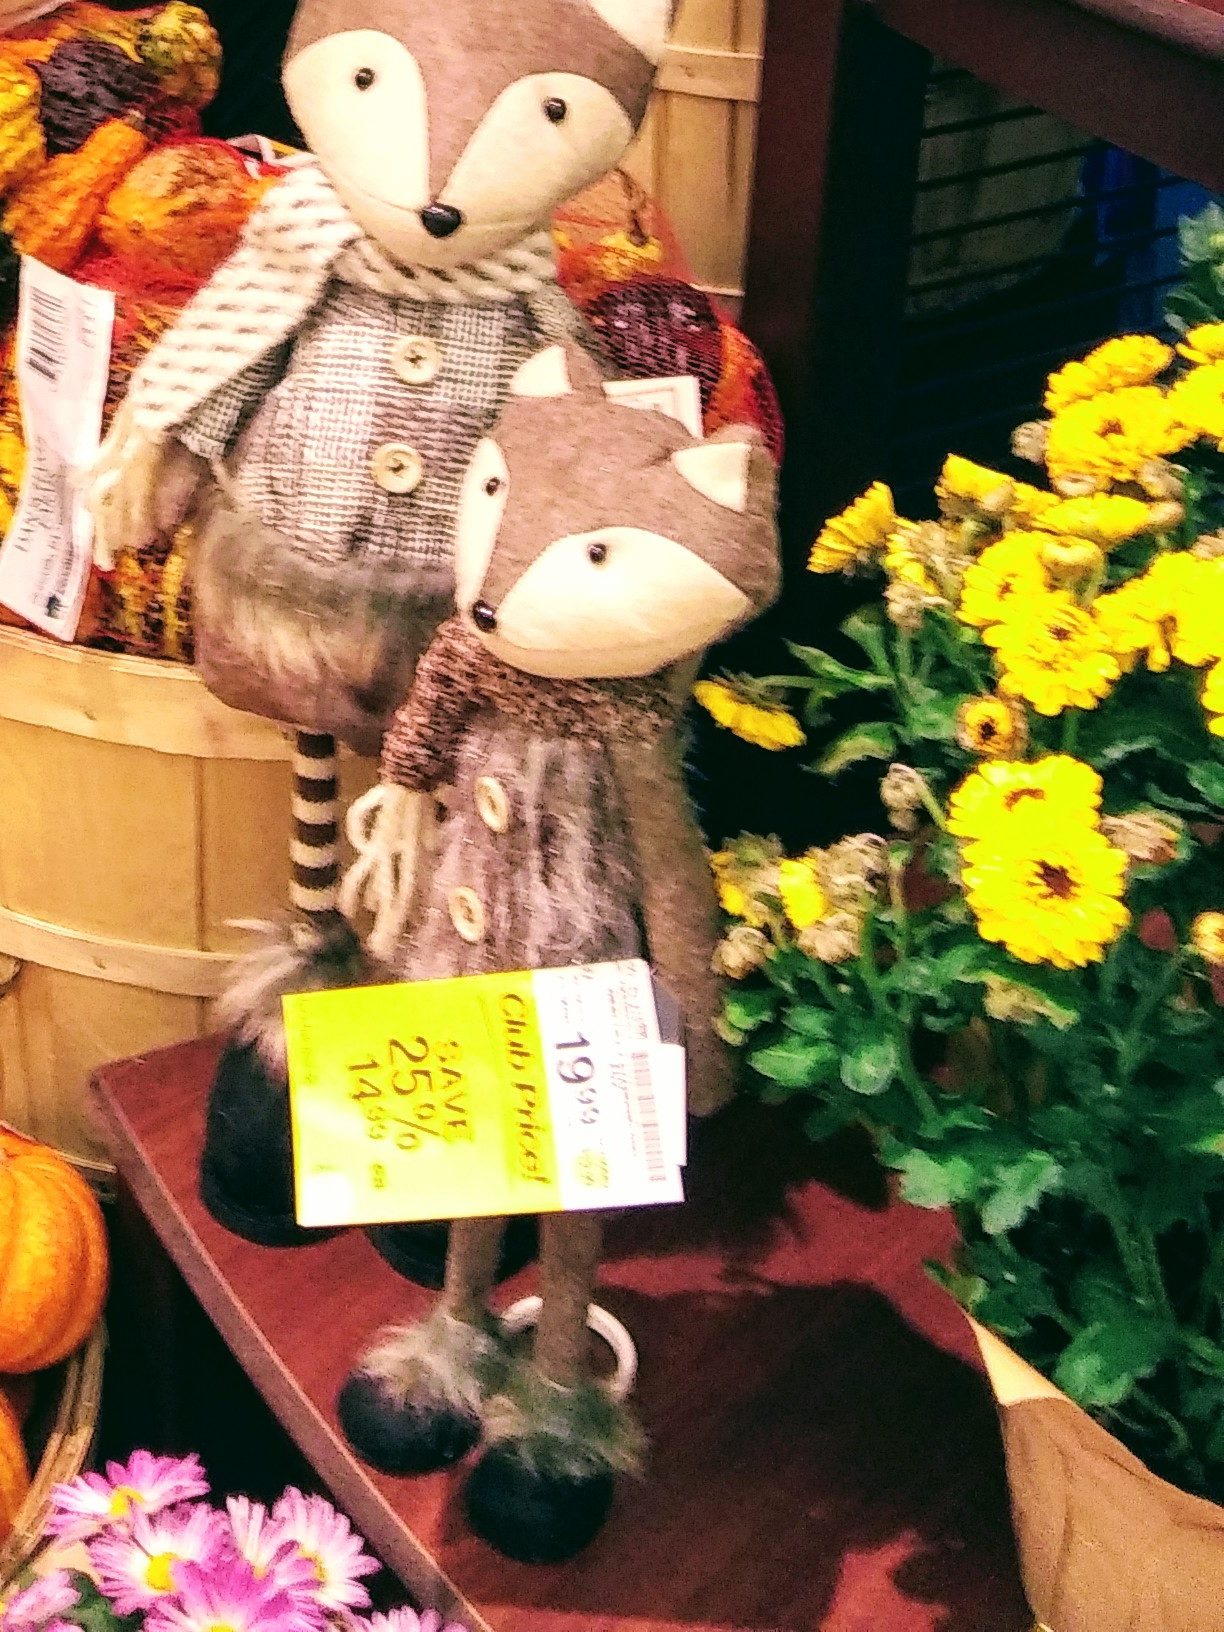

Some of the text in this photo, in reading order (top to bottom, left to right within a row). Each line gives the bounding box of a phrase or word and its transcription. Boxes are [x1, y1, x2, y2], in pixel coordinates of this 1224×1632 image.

[387, 1035, 445, 1150] 25%
[434, 1039, 473, 1142] SAVE
[500, 993, 551, 1184] Club Price!
